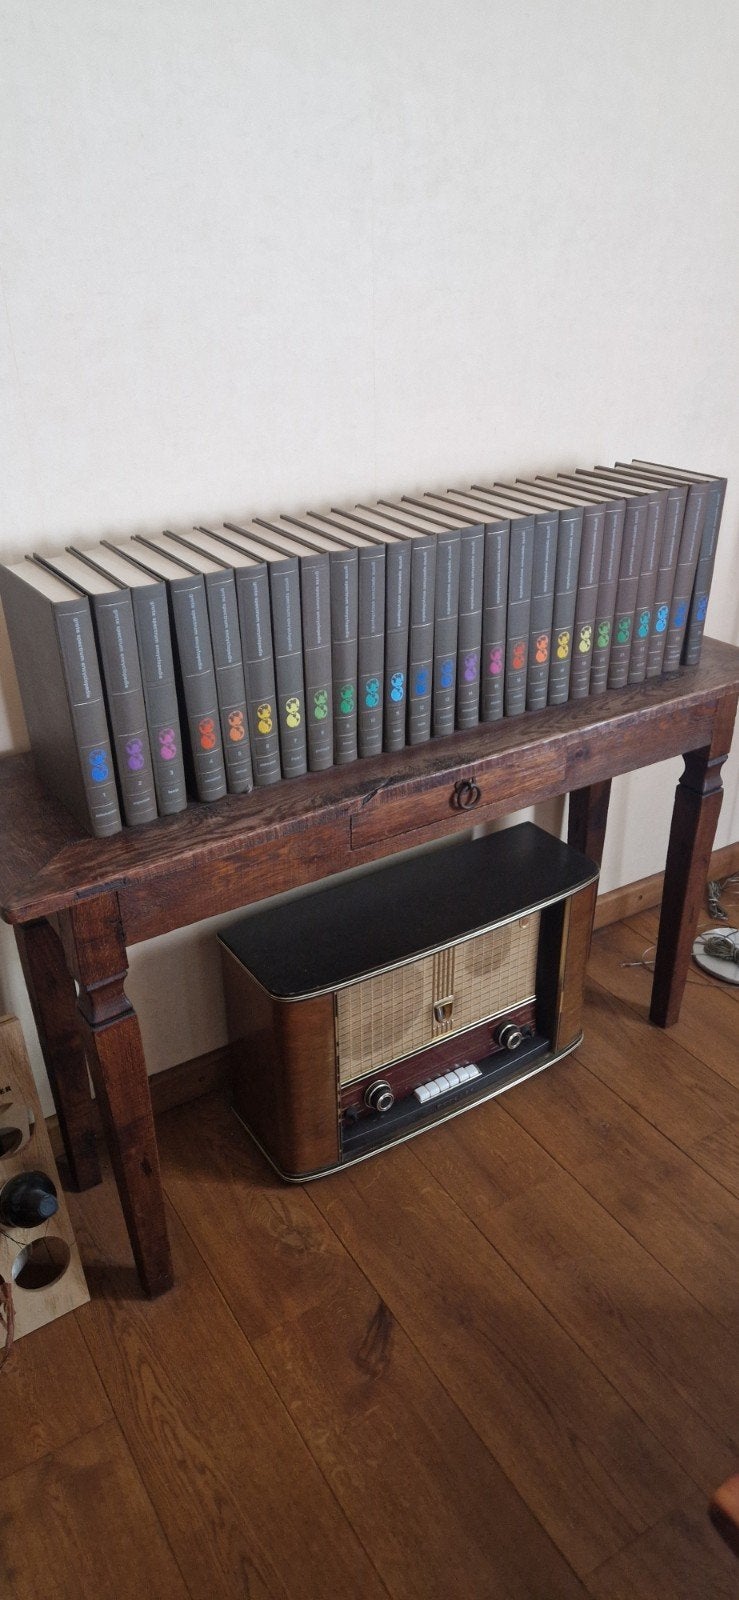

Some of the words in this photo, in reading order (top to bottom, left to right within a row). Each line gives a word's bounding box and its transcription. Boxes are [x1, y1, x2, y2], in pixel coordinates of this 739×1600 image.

[115, 626, 124, 652] spectrum
[151, 618, 159, 643] spectrum
[76, 634, 85, 661] spectrum
[154, 645, 163, 679] encyclopedie
[80, 662, 91, 699] encyclopedie
[119, 653, 129, 688] encyclopedie
